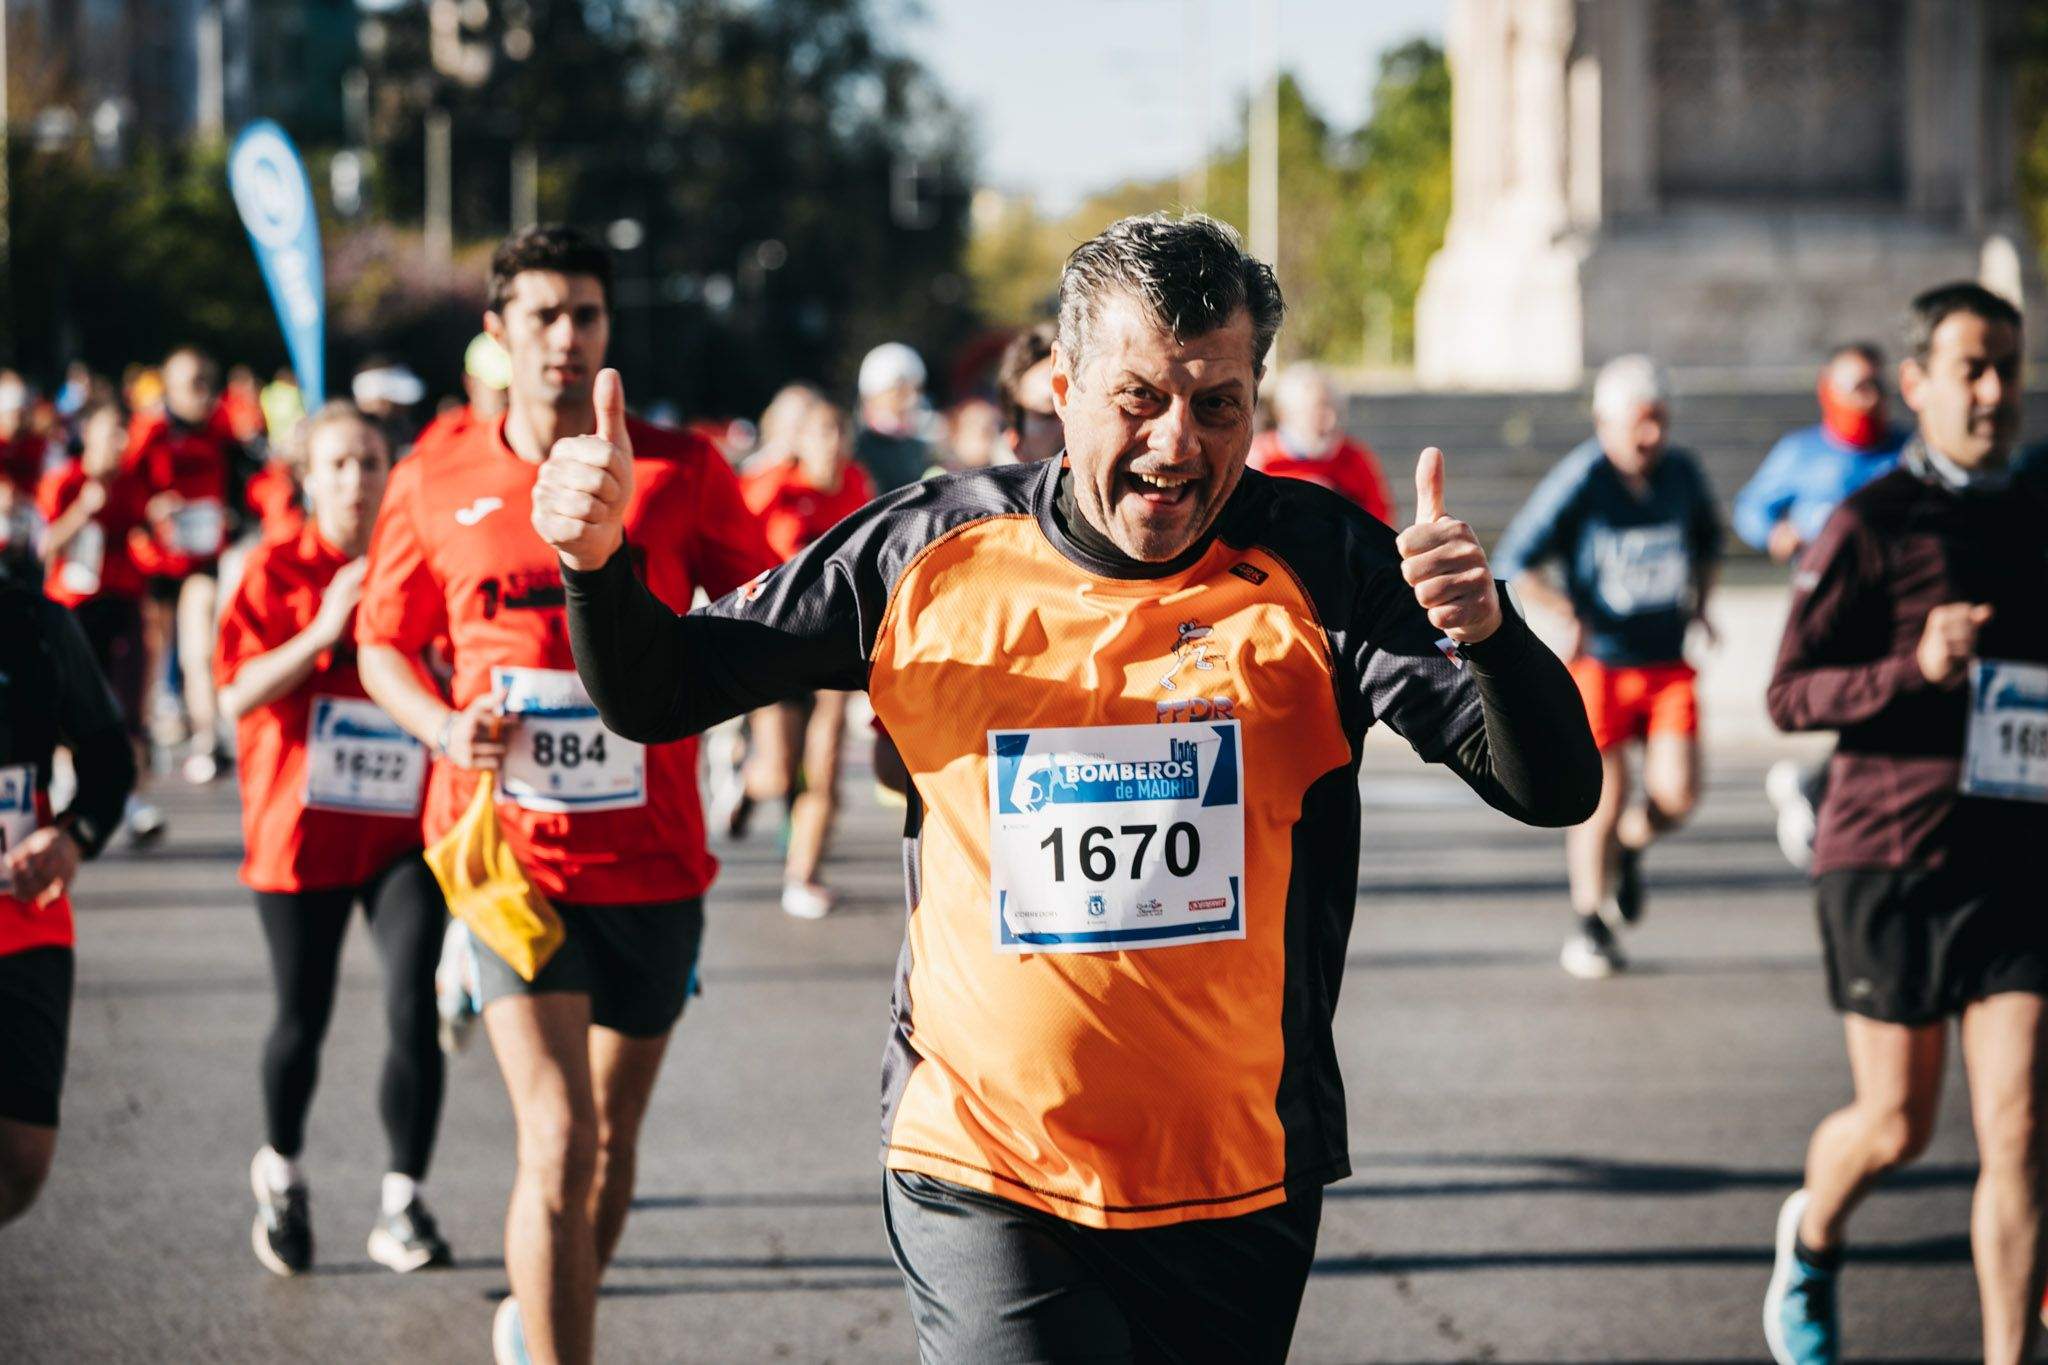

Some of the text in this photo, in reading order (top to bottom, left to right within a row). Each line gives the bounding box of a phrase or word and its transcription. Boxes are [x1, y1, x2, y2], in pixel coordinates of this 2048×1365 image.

[534, 732, 607, 767] 884
[1065, 761, 1194, 783] BOMBEROS
[1115, 779, 1195, 799] de MADRID
[1040, 821, 1201, 883] 1670
